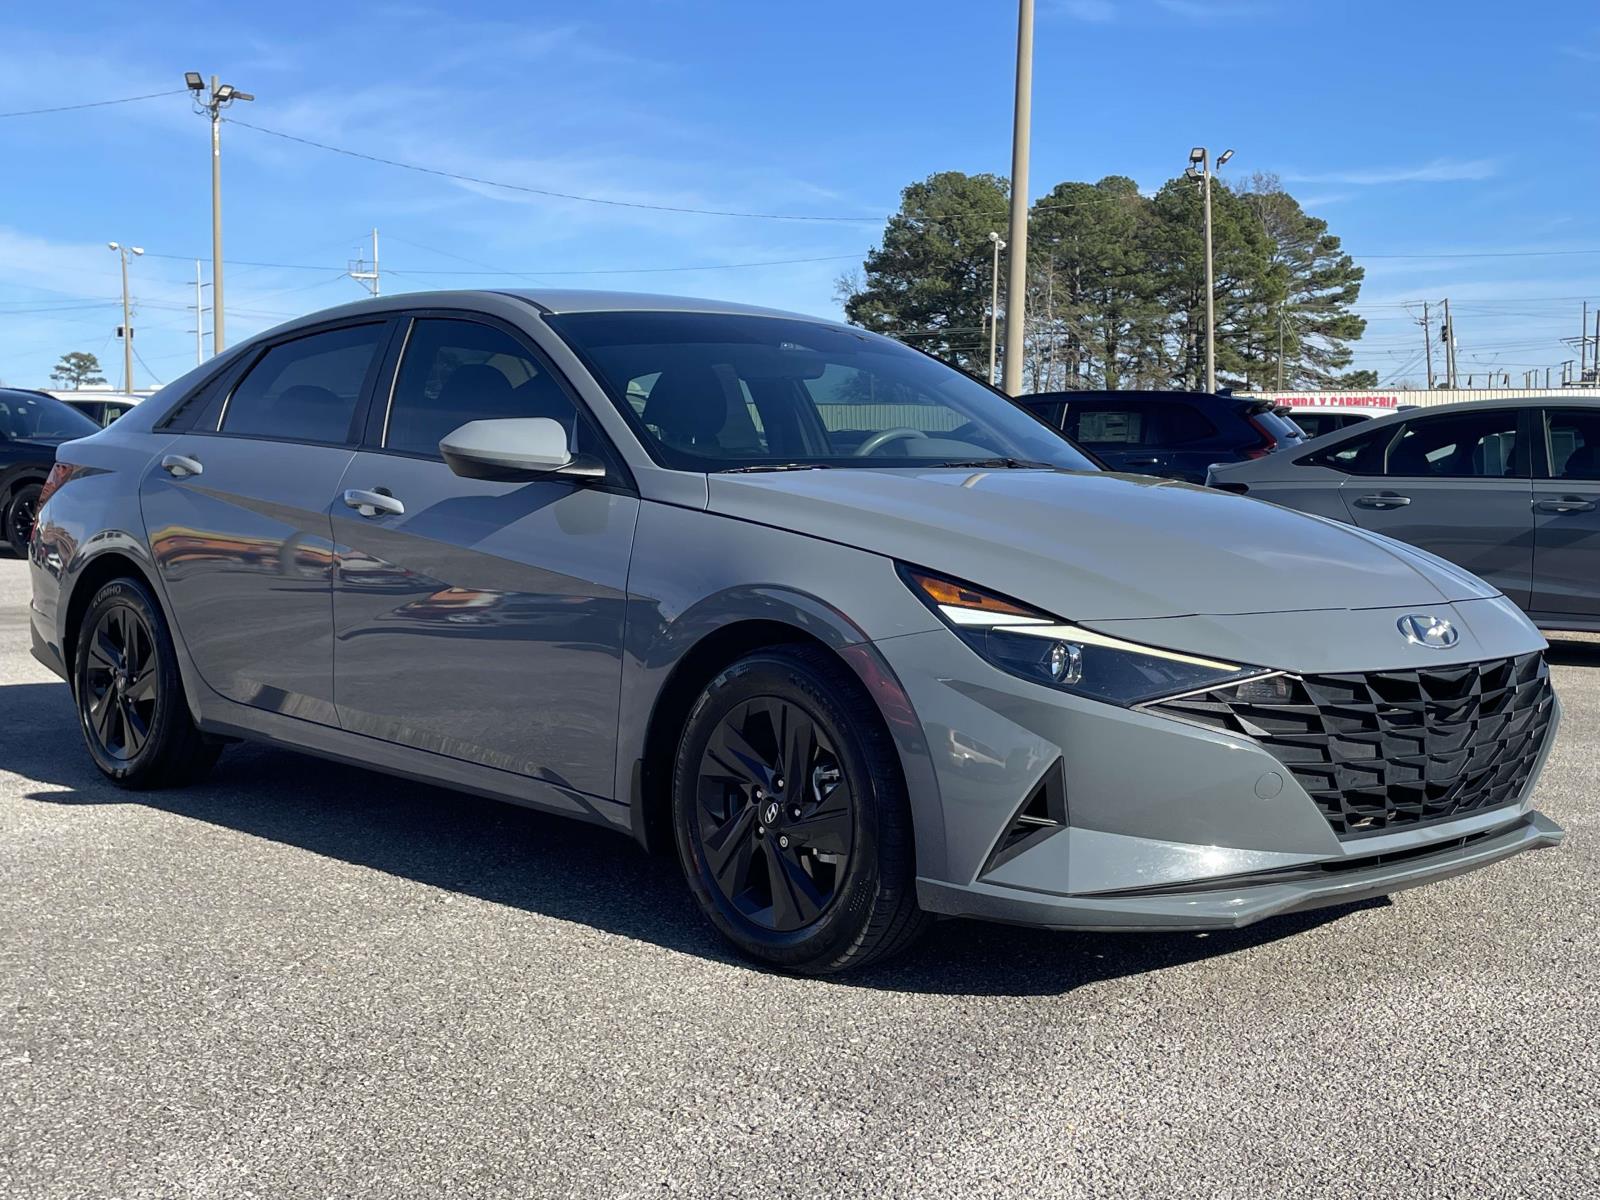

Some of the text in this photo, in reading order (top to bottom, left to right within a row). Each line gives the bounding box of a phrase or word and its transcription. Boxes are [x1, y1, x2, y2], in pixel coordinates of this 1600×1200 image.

[1276, 397, 1398, 408] TIENDA Y CARNICERIA
